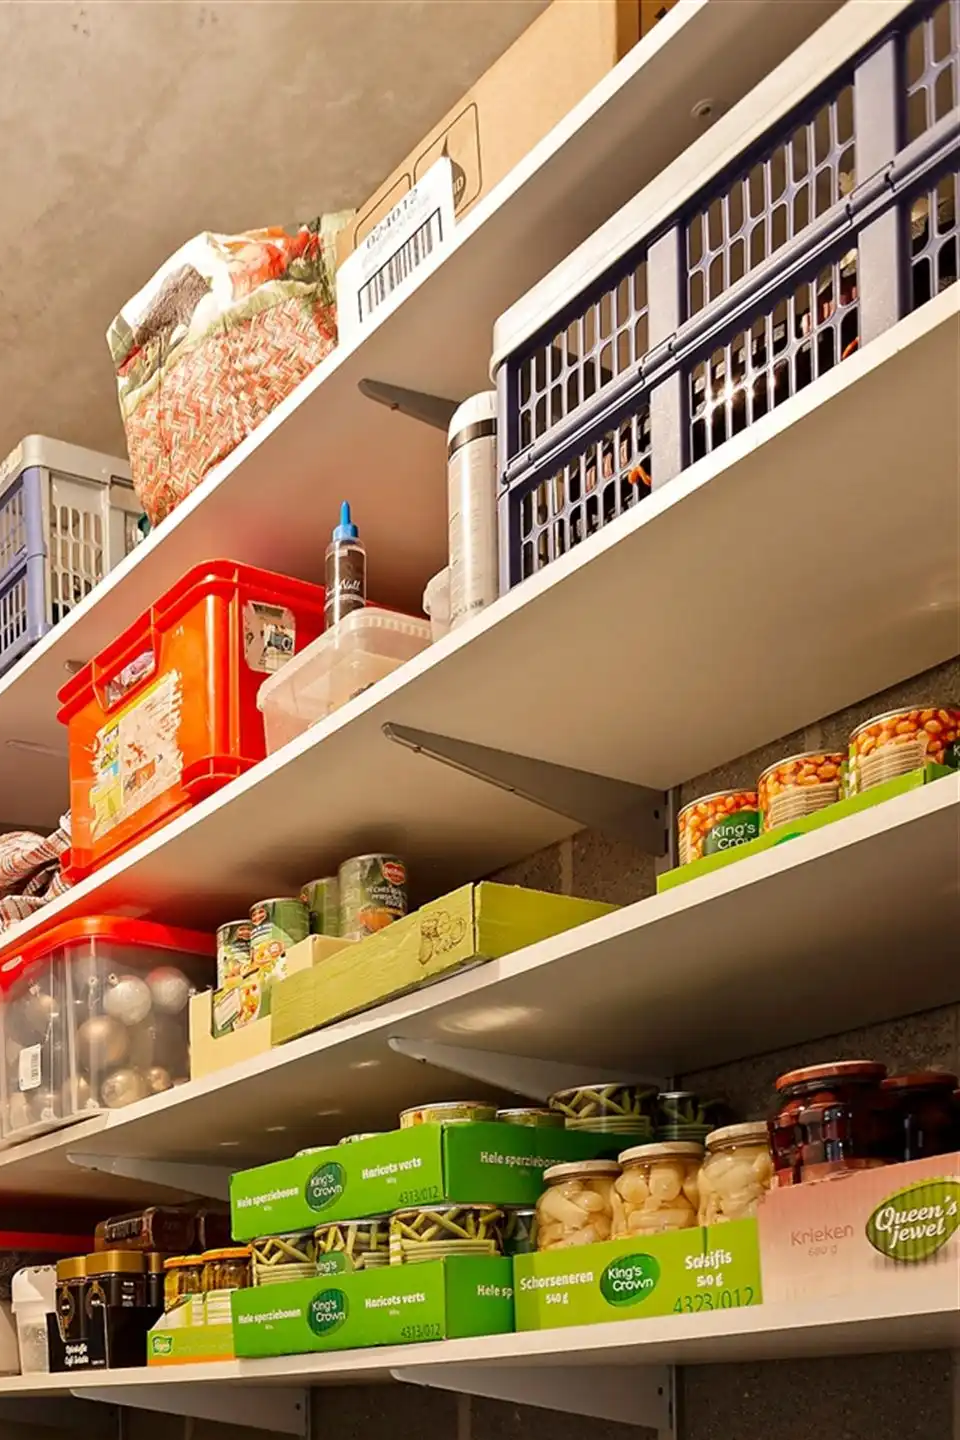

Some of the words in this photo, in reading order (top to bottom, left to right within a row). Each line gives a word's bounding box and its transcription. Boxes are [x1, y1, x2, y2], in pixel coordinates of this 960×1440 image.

[710, 821, 757, 840] King's
[480, 1151, 503, 1164] Hele
[361, 1162, 398, 1180] Haricots
[398, 1155, 422, 1170] verts
[309, 1173, 336, 1188] King's
[312, 1184, 343, 1198] Crown
[874, 1194, 958, 1233] Queen's
[790, 1224, 855, 1247] Krieken
[888, 1217, 946, 1249] jewel
[684, 1249, 733, 1271] Salsifis
[519, 1270, 594, 1291] Schorseneren
[607, 1265, 643, 1280] King's
[476, 1285, 500, 1297] Hele
[611, 1277, 654, 1292] Crown
[311, 1299, 338, 1312] King's
[364, 1295, 401, 1309] Haricots
[401, 1291, 426, 1304] verts
[672, 1286, 755, 1313] 4323/012
[315, 1311, 346, 1323] Crown
